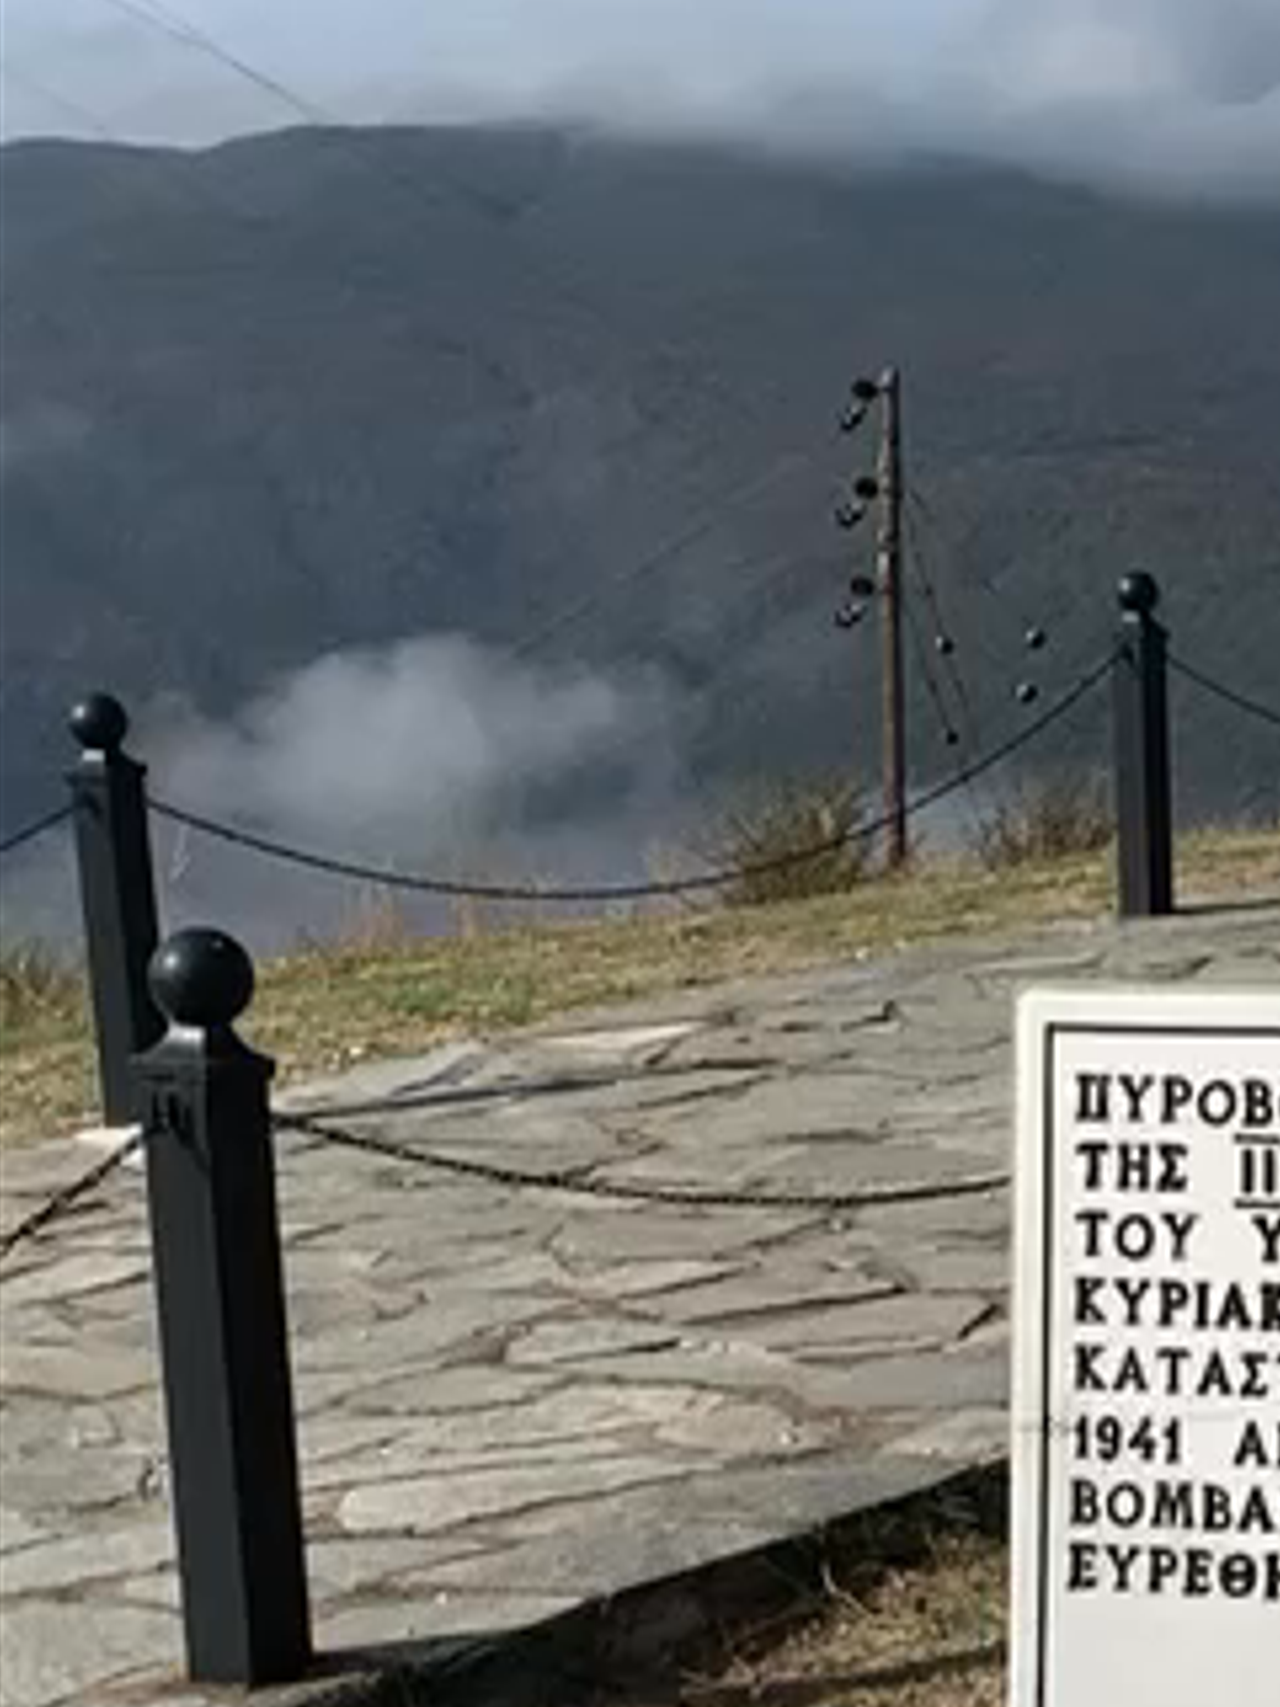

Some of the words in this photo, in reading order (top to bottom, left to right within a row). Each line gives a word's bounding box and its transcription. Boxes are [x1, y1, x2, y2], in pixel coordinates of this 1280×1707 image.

[1075, 1141, 1188, 1193] ΤΗΣ
[1074, 1210, 1197, 1262] ΤΟΥ
[1074, 1414, 1180, 1465] 1941
